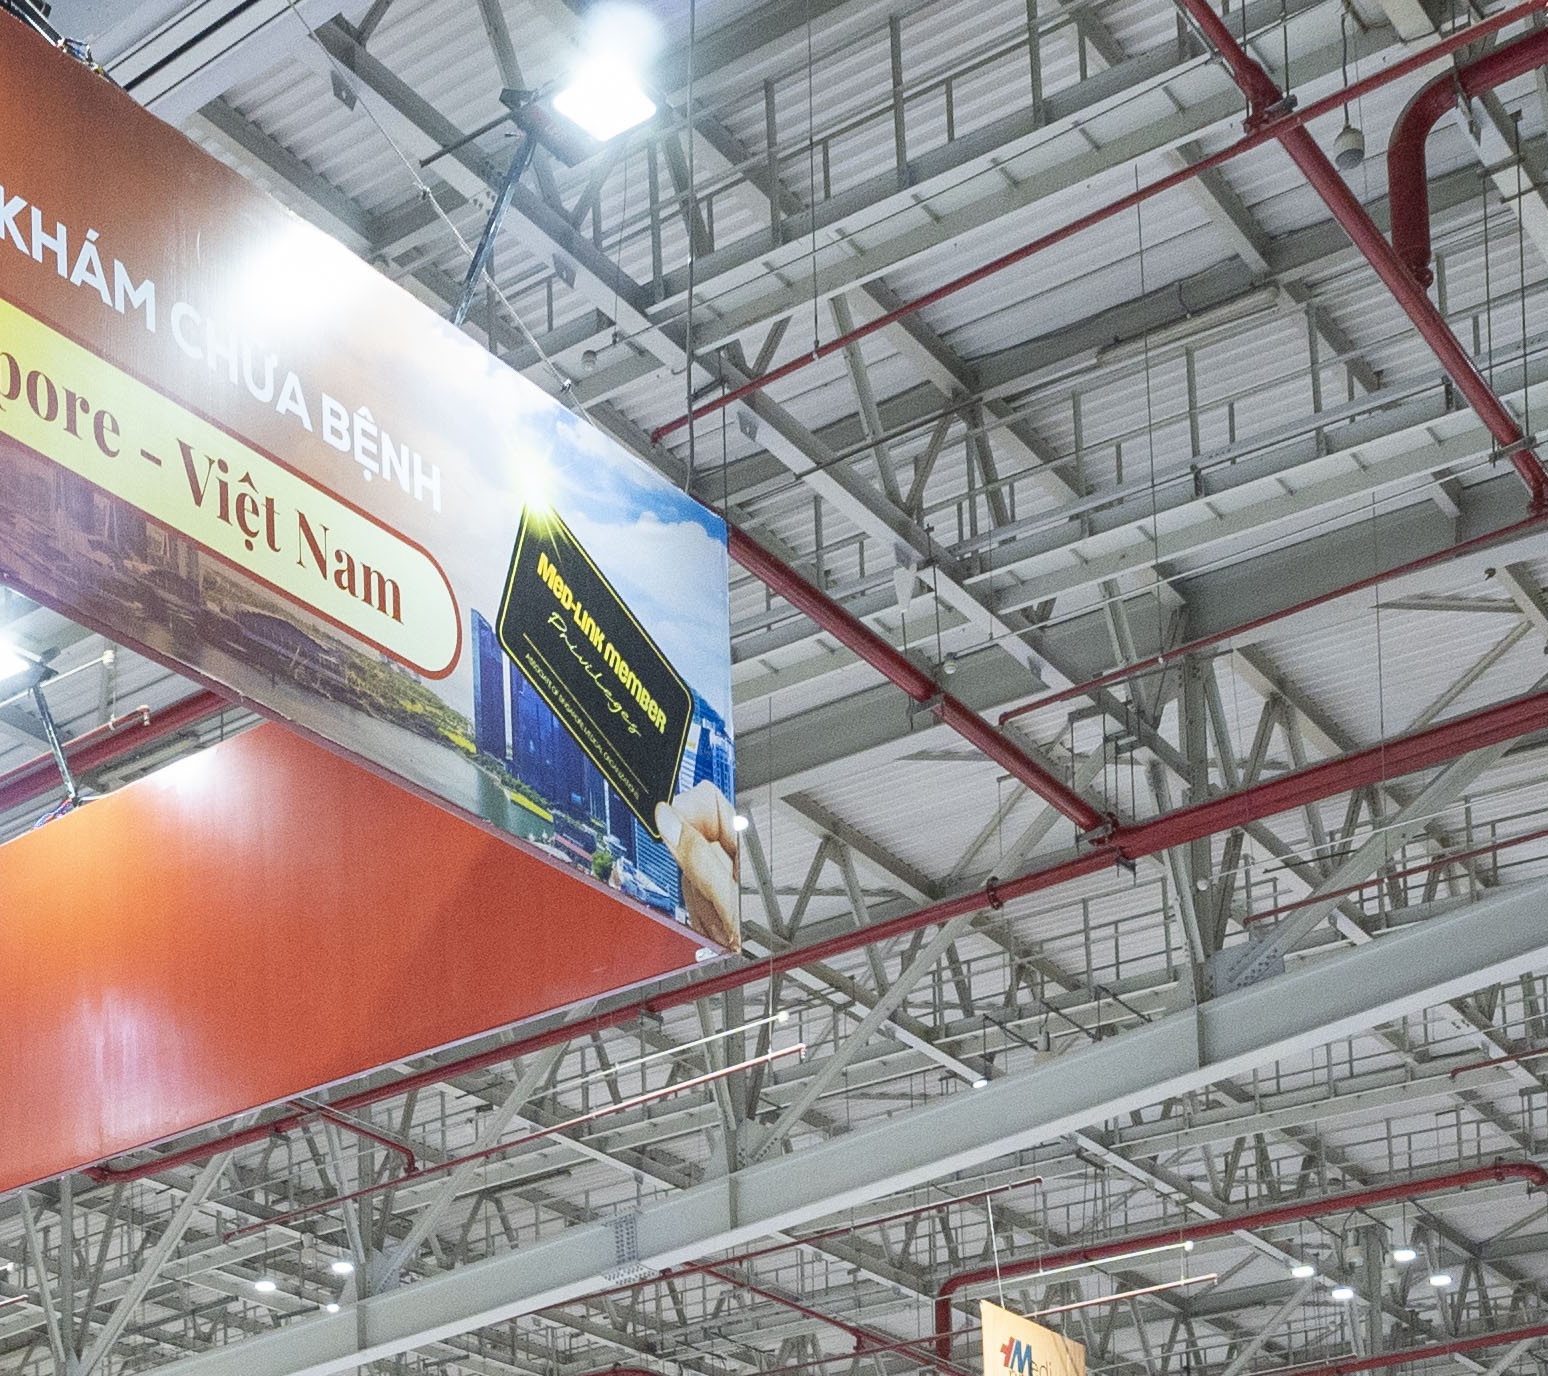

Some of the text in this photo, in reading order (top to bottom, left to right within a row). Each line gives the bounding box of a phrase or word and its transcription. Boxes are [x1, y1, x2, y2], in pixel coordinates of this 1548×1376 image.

[321, 390, 443, 512] BỆNH
[181, 443, 283, 554] Việt
[298, 507, 406, 625] Nam
